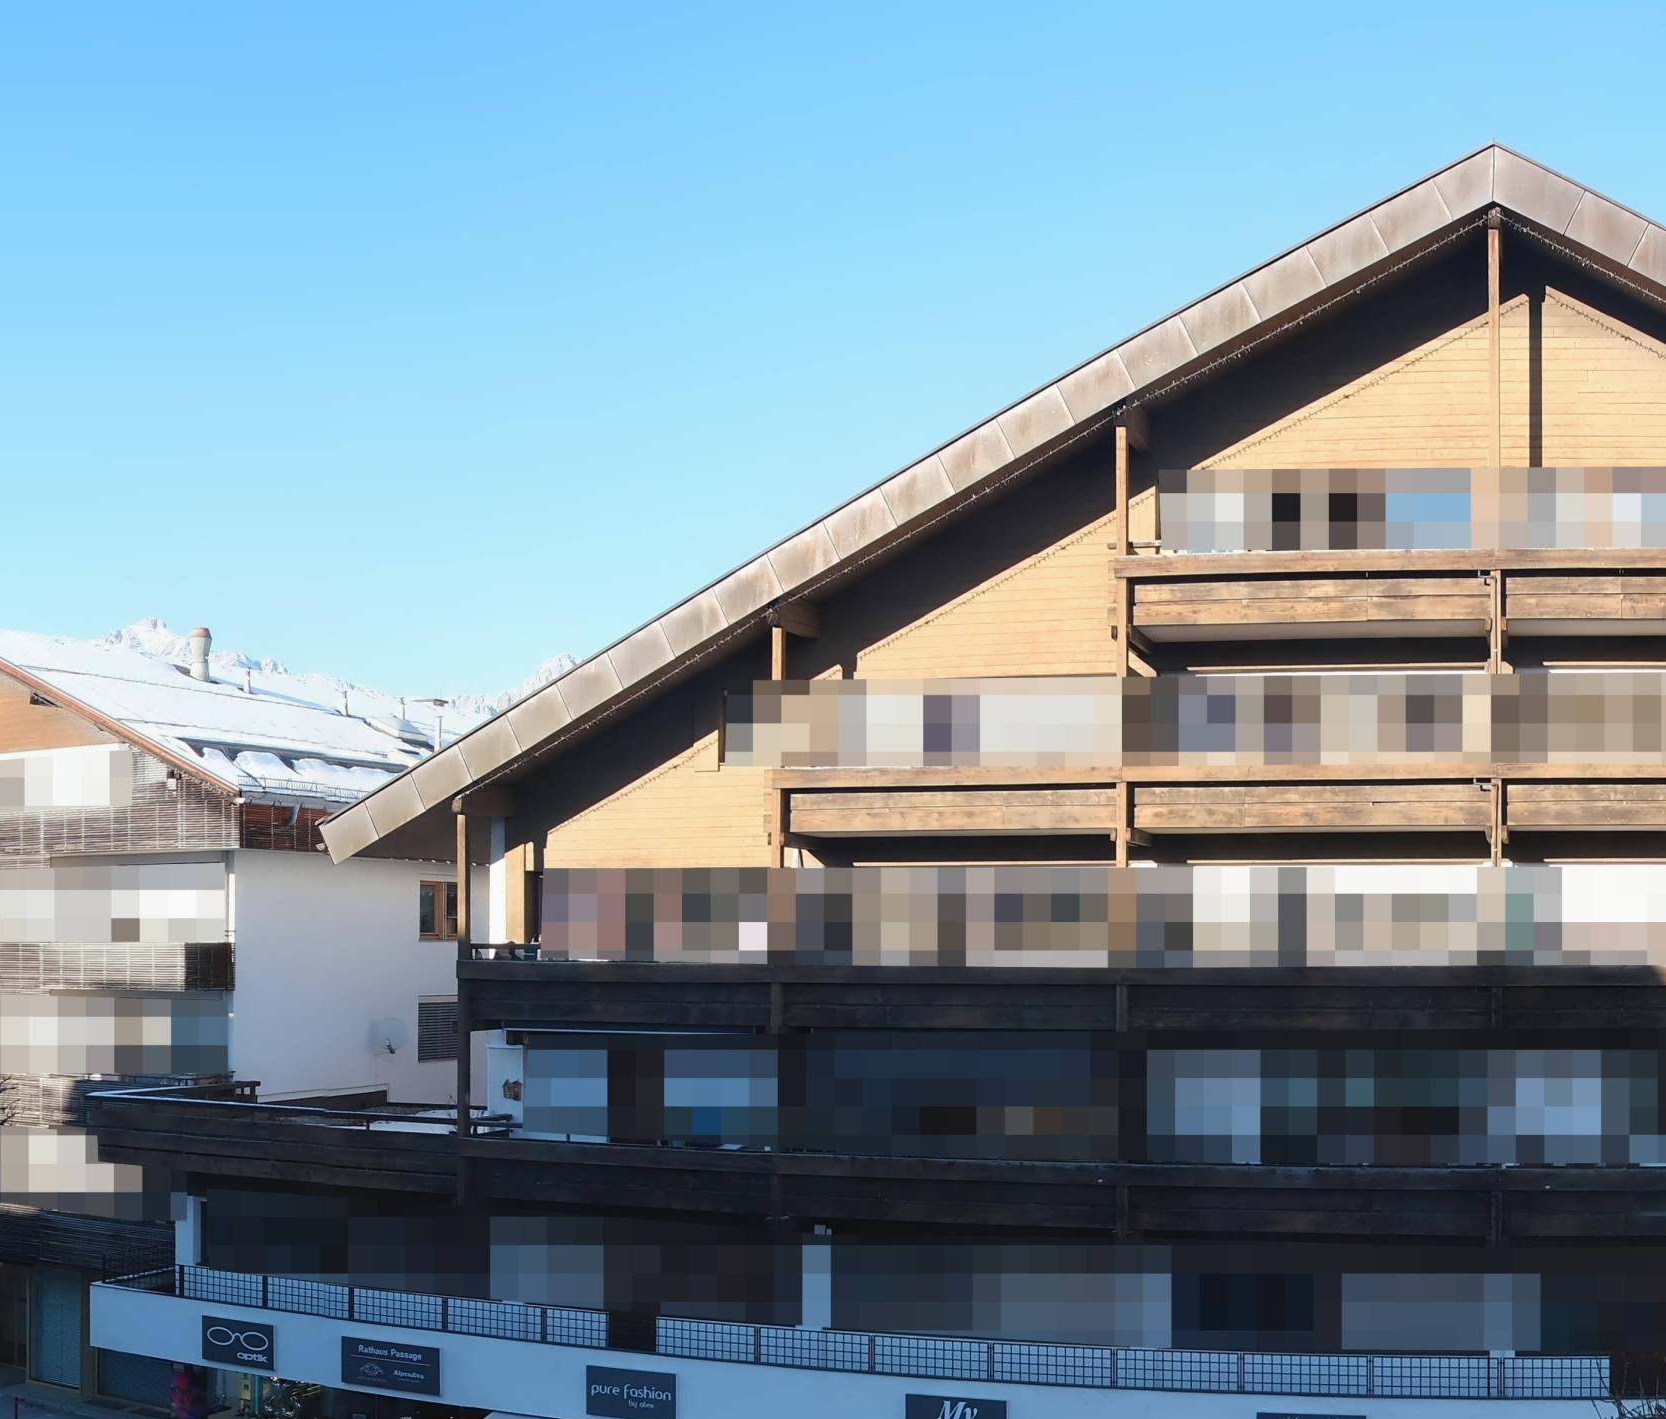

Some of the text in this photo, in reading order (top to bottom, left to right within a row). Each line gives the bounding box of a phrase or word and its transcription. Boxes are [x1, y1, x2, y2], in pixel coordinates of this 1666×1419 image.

[236, 1352, 268, 1363] optik
[357, 1344, 423, 1362] Rathaus Passage
[591, 1383, 672, 1401] pure fashion
